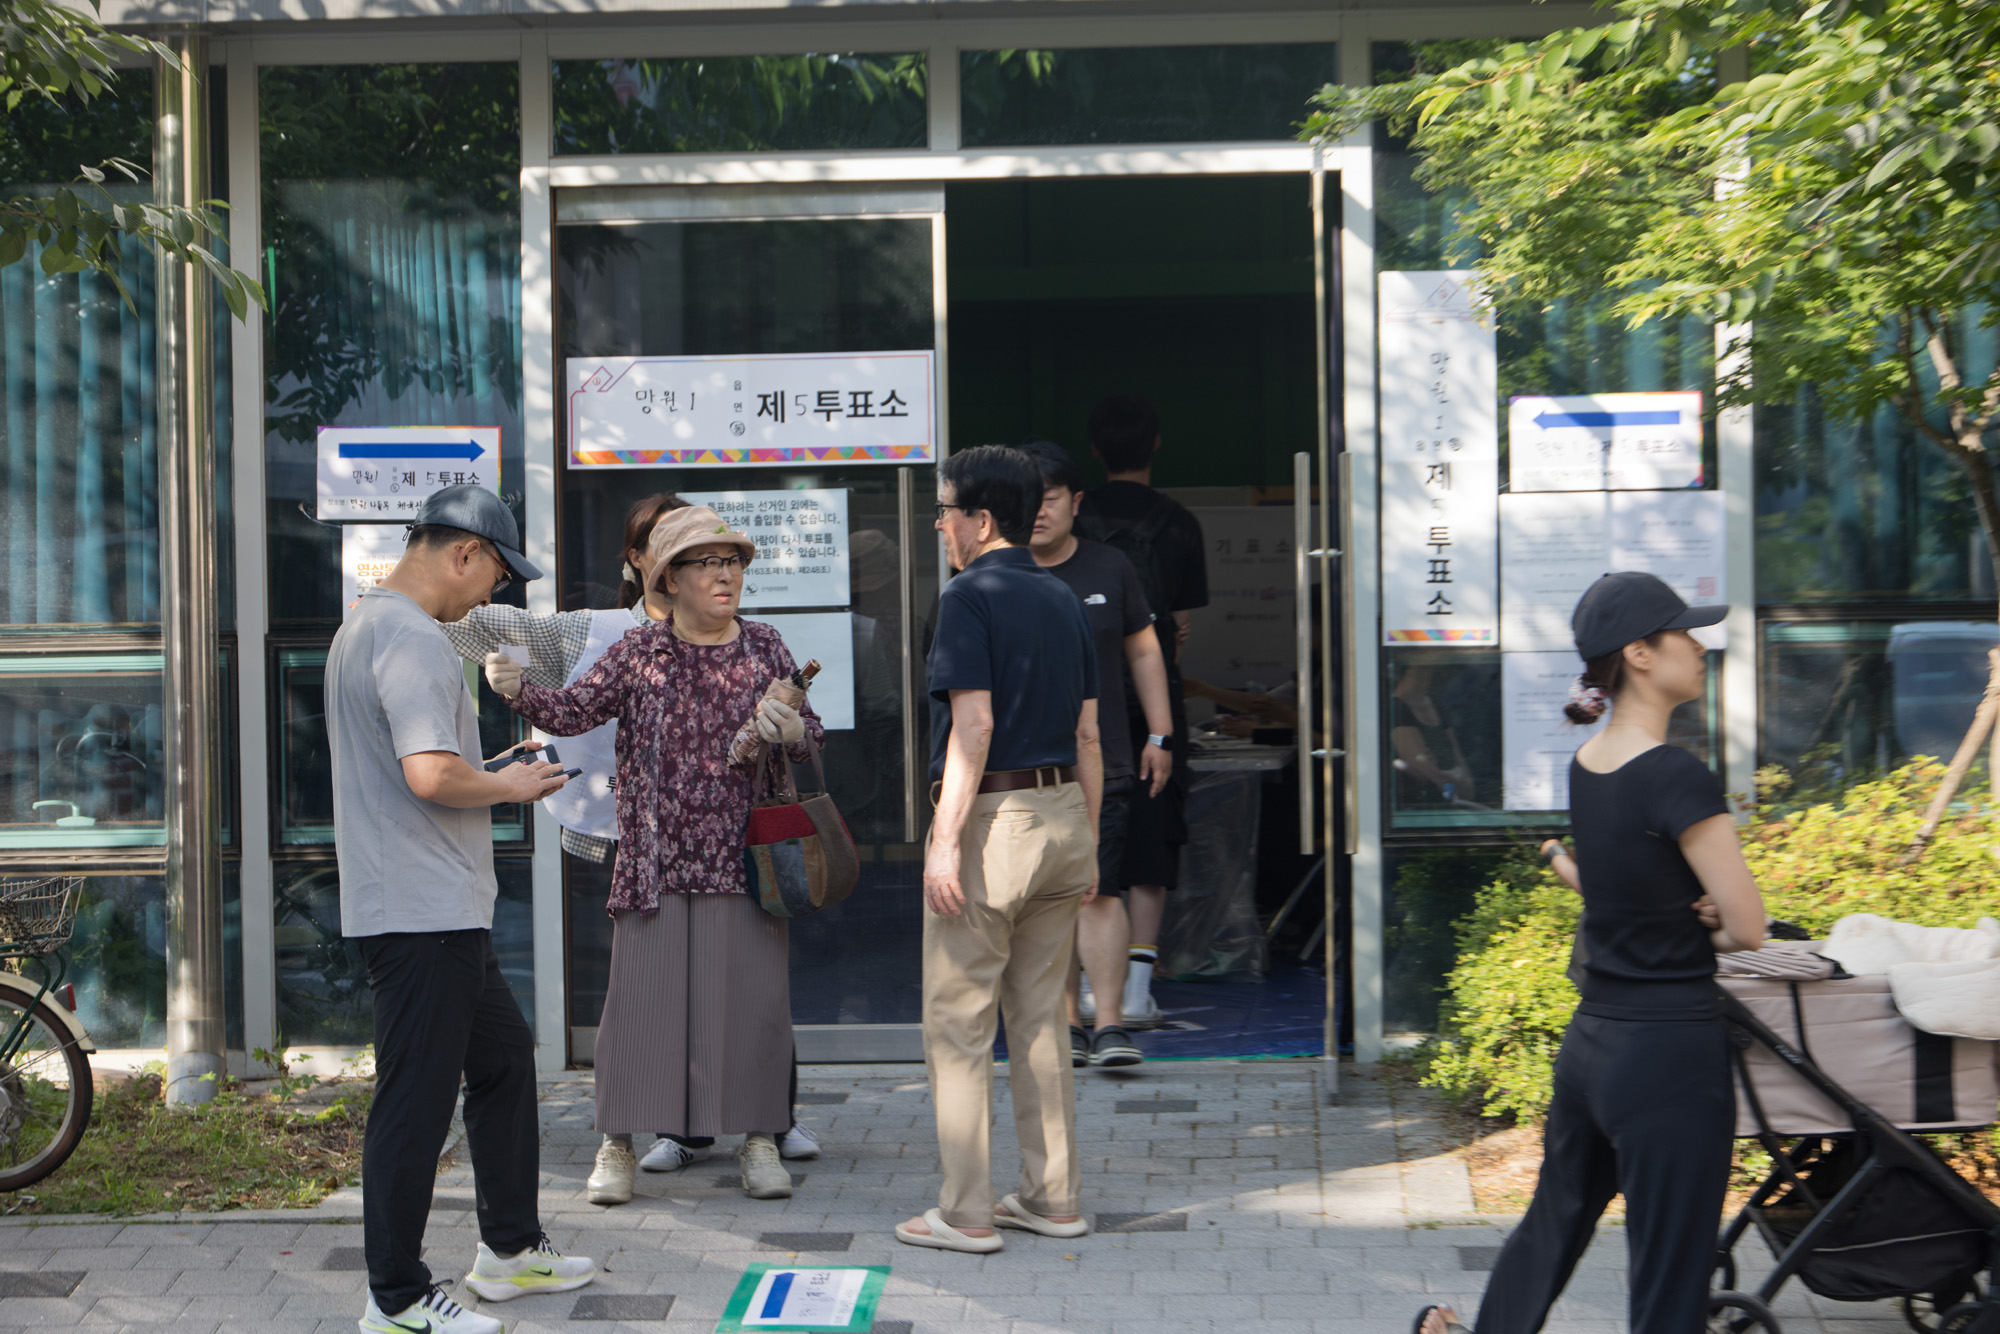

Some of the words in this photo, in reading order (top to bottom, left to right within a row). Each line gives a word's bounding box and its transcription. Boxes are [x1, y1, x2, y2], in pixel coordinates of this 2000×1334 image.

[634, 389, 679, 414] 망원
[707, 501, 754, 513] 투표하려는
[758, 499, 787, 512] 선거인
[790, 498, 819, 511] 외에는
[722, 515, 750, 527] 표소에
[754, 514, 782, 526] 출입할
[786, 514, 795, 526] 수
[799, 512, 841, 525] 없습니다.
[781, 533, 801, 546] 다시
[804, 532, 833, 545] 투표를
[754, 547, 781, 560] 벌받을
[785, 547, 794, 558] 수
[798, 545, 840, 558] 있습니다.
